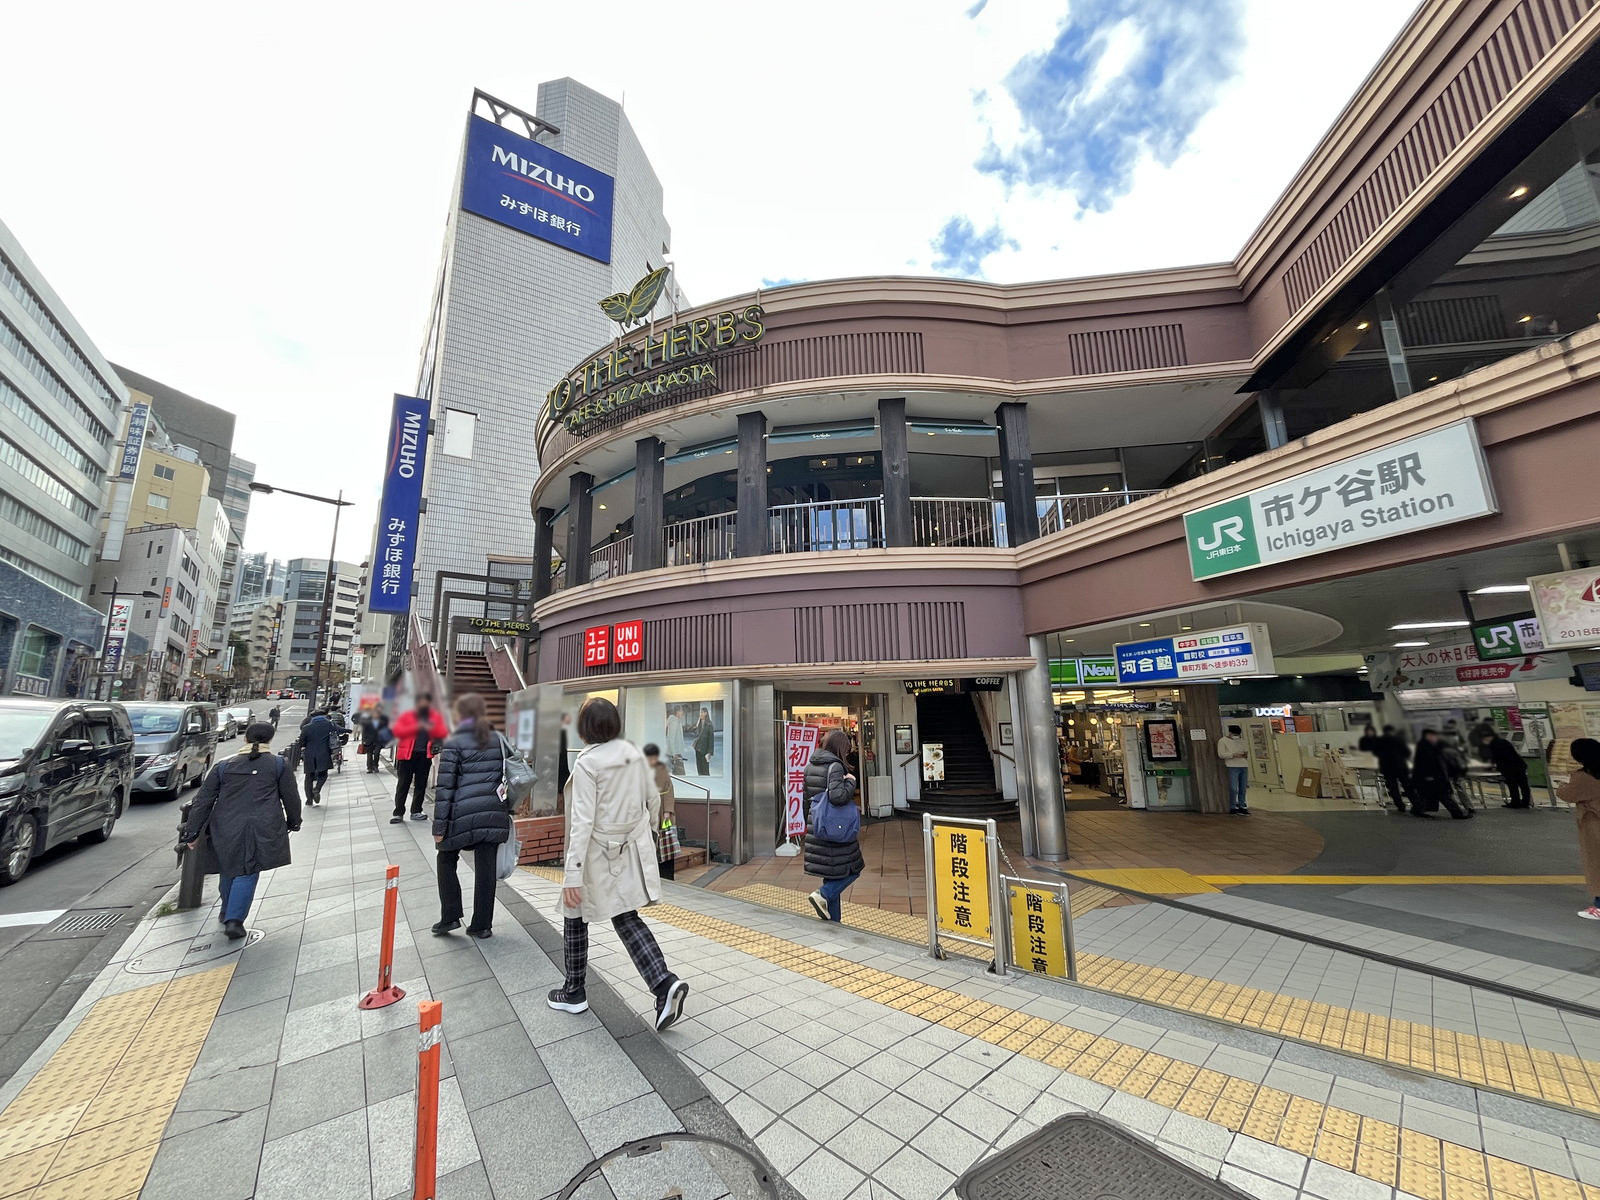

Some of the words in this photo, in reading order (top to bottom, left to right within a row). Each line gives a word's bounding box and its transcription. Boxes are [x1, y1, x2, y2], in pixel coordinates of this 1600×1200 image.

[491, 144, 595, 203] MIZUHO
[500, 194, 582, 237] みずほ銀行
[580, 343, 636, 397] THE
[644, 304, 766, 369] HERBS
[562, 405, 592, 432] CAFE
[608, 381, 652, 408] PIZZA
[657, 363, 717, 394] PASTA
[398, 410, 422, 479] MIZUHO
[1197, 515, 1246, 551] JR
[1266, 520, 1354, 552] Ichigaya
[1361, 493, 1454, 529] Station
[381, 517, 406, 595] みずほ銀行
[1206, 544, 1242, 561] JR東日本
[469, 617, 484, 627] TO
[485, 619, 501, 629] THE
[503, 620, 531, 632] HERBS
[588, 630, 606, 646] ユニ
[617, 625, 638, 642] UNI
[1480, 625, 1515, 649] JR
[587, 647, 605, 662] クロ
[617, 641, 639, 658] QLO
[1121, 655, 1174, 675] 河合塾
[929, 679, 954, 687] HERBS
[975, 677, 1000, 685] COFFEE
[788, 744, 809, 819] 初売り
[950, 833, 972, 928] 階段注意
[1026, 893, 1048, 975] 階段注意
